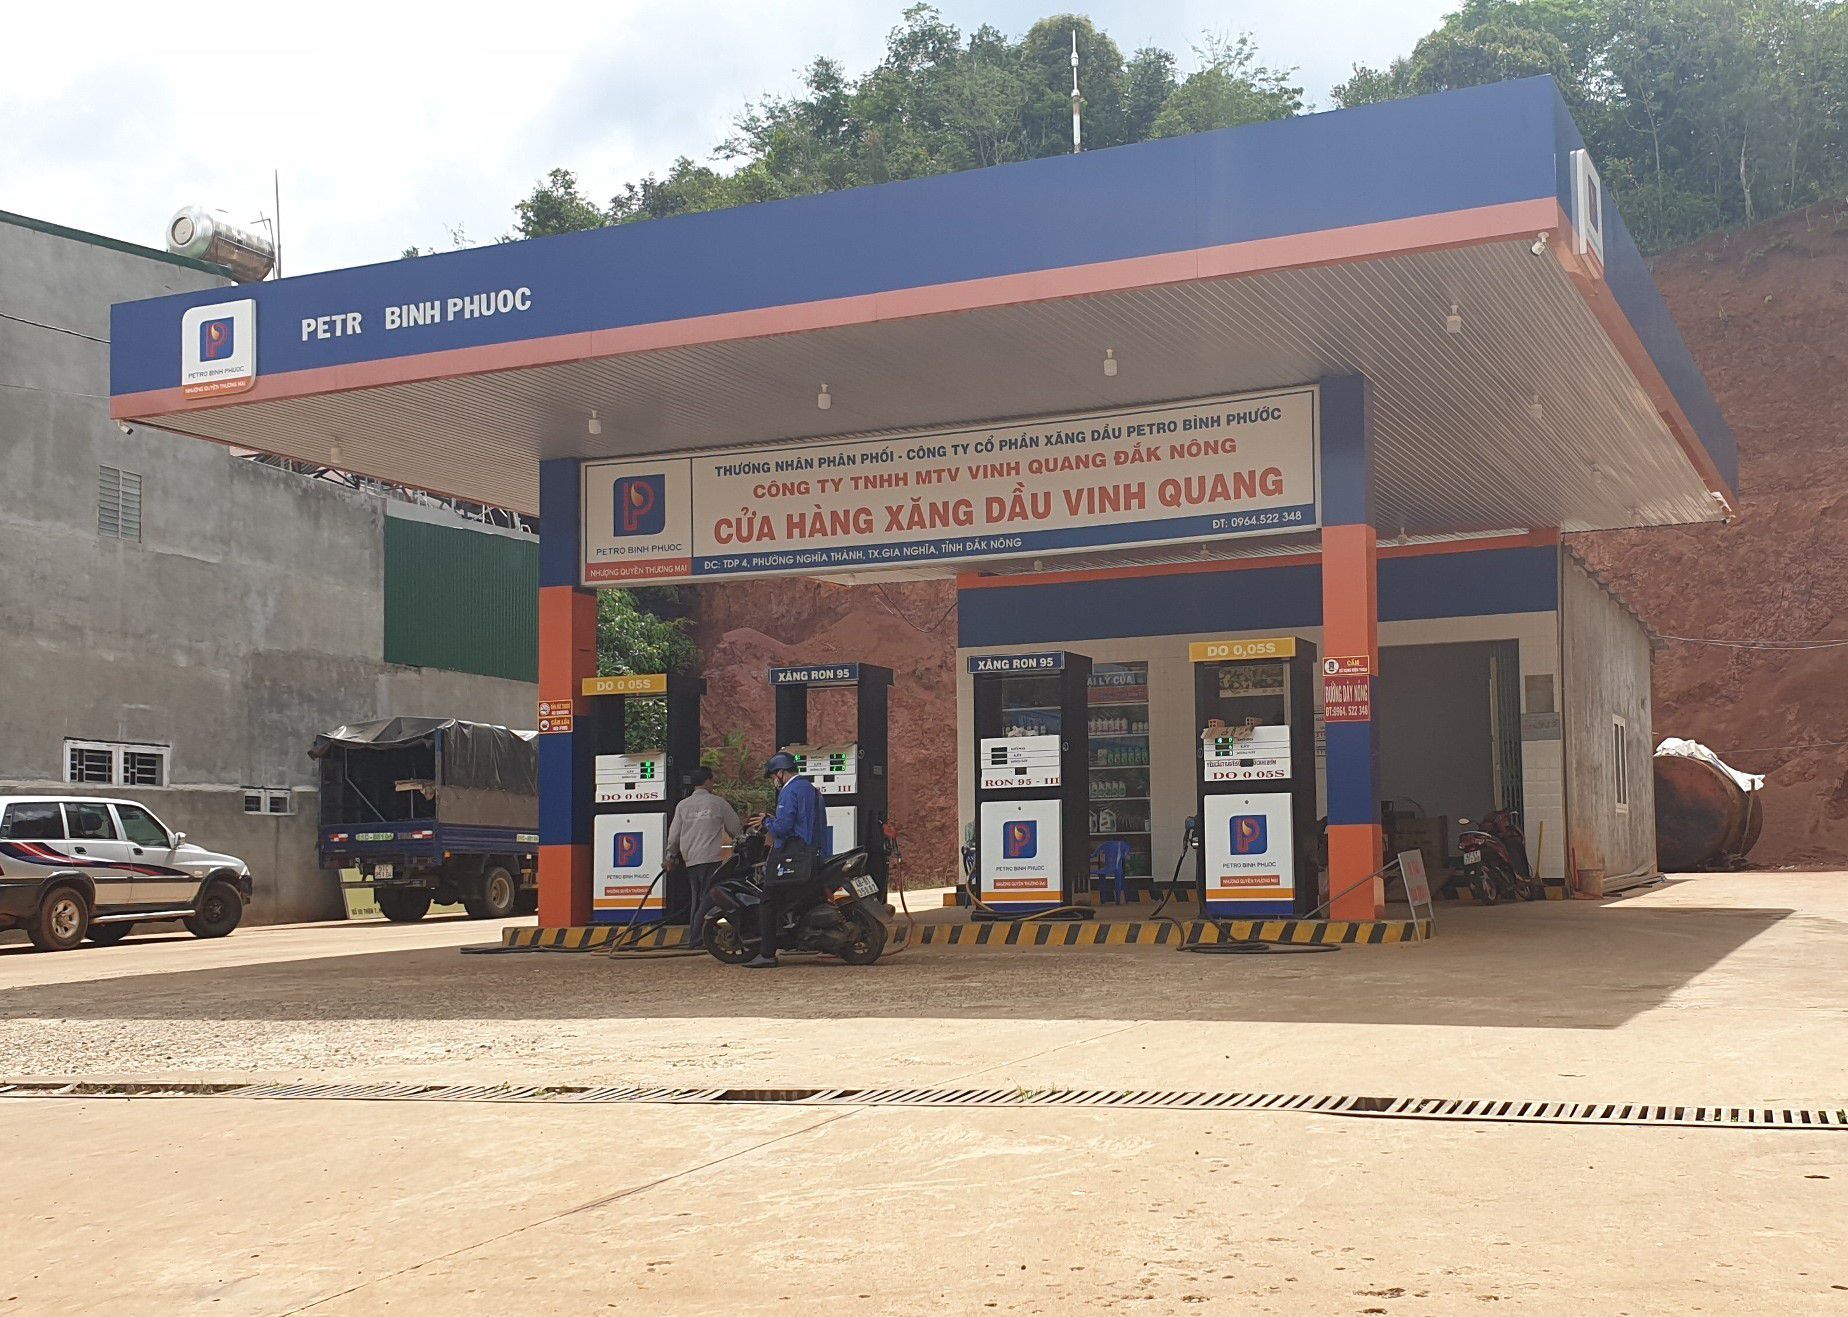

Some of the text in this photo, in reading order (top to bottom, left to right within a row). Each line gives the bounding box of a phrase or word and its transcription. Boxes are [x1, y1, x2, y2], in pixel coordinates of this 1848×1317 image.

[301, 287, 532, 342] PETR BINH PHUOC
[715, 461, 771, 477] THƯƠNG
[775, 457, 814, 472] NHÂN
[818, 452, 856, 468] PHÂN
[860, 446, 894, 464] PHỐI
[907, 445, 947, 460] CÔNG
[951, 443, 970, 456] TY
[974, 434, 995, 454] CỔ
[999, 432, 1040, 452] PHẦN
[1044, 430, 1086, 446] XĂNG
[1091, 422, 1122, 441] DẦU
[1127, 420, 1178, 438] PETRO
[1183, 414, 1221, 431] BÌNH
[1226, 405, 1282, 425] PHƯỚC
[753, 438, 1237, 499] CÔNG TY TNHH MTV VINH QUANG ĐẮK NÔNG
[714, 466, 1284, 545] CỬA HÀNG XĂNG DẦU VINH QUANG
[1212, 511, 1302, 529] ĐT: 0964.522 348
[596, 543, 682, 556] PETRO BINH PHUOC
[704, 560, 721, 570] ĐC:
[752, 552, 795, 566] PHƯỜNG
[990, 536, 1022, 549] NÔNG
[1207, 643, 1276, 657] DO 0,05S
[977, 656, 1054, 671] XĂNG RON 95
[778, 669, 850, 682] XĂNG RON 95
[596, 679, 651, 692] DO 0 05S
[1213, 769, 1285, 780] DO 0 05S
[985, 779, 1014, 787] RON
[1017, 778, 1032, 786] 95
[601, 793, 621, 801] DO
[635, 791, 659, 800] 05S
